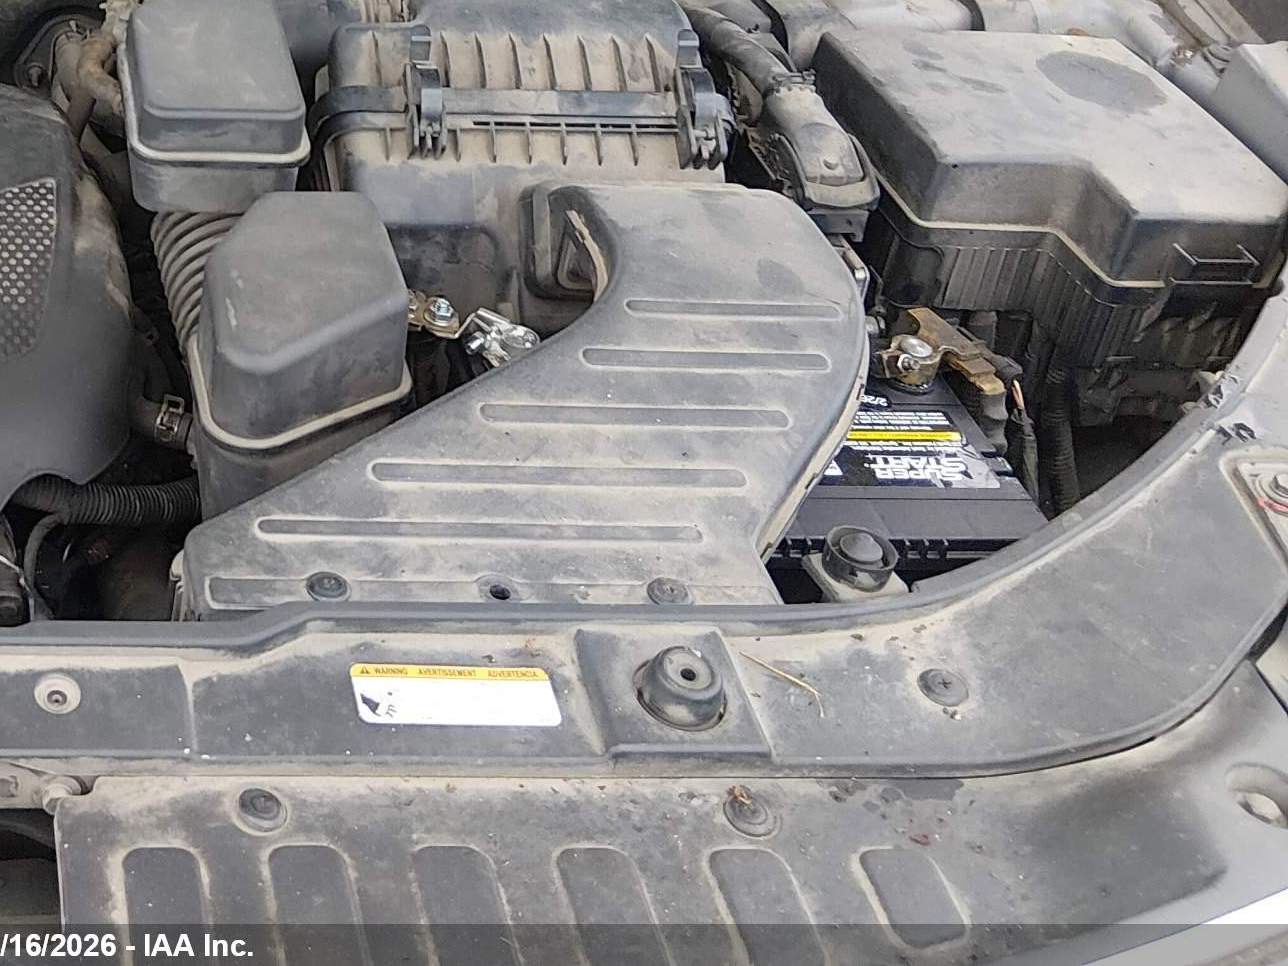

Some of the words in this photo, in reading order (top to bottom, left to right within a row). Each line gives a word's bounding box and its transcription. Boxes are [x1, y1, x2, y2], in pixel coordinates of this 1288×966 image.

[874, 467, 965, 482] SUPER
[374, 667, 408, 676] WARNING
[418, 668, 477, 678] AVERTISSEMENT
[487, 670, 538, 678] ADVERTENCIA
